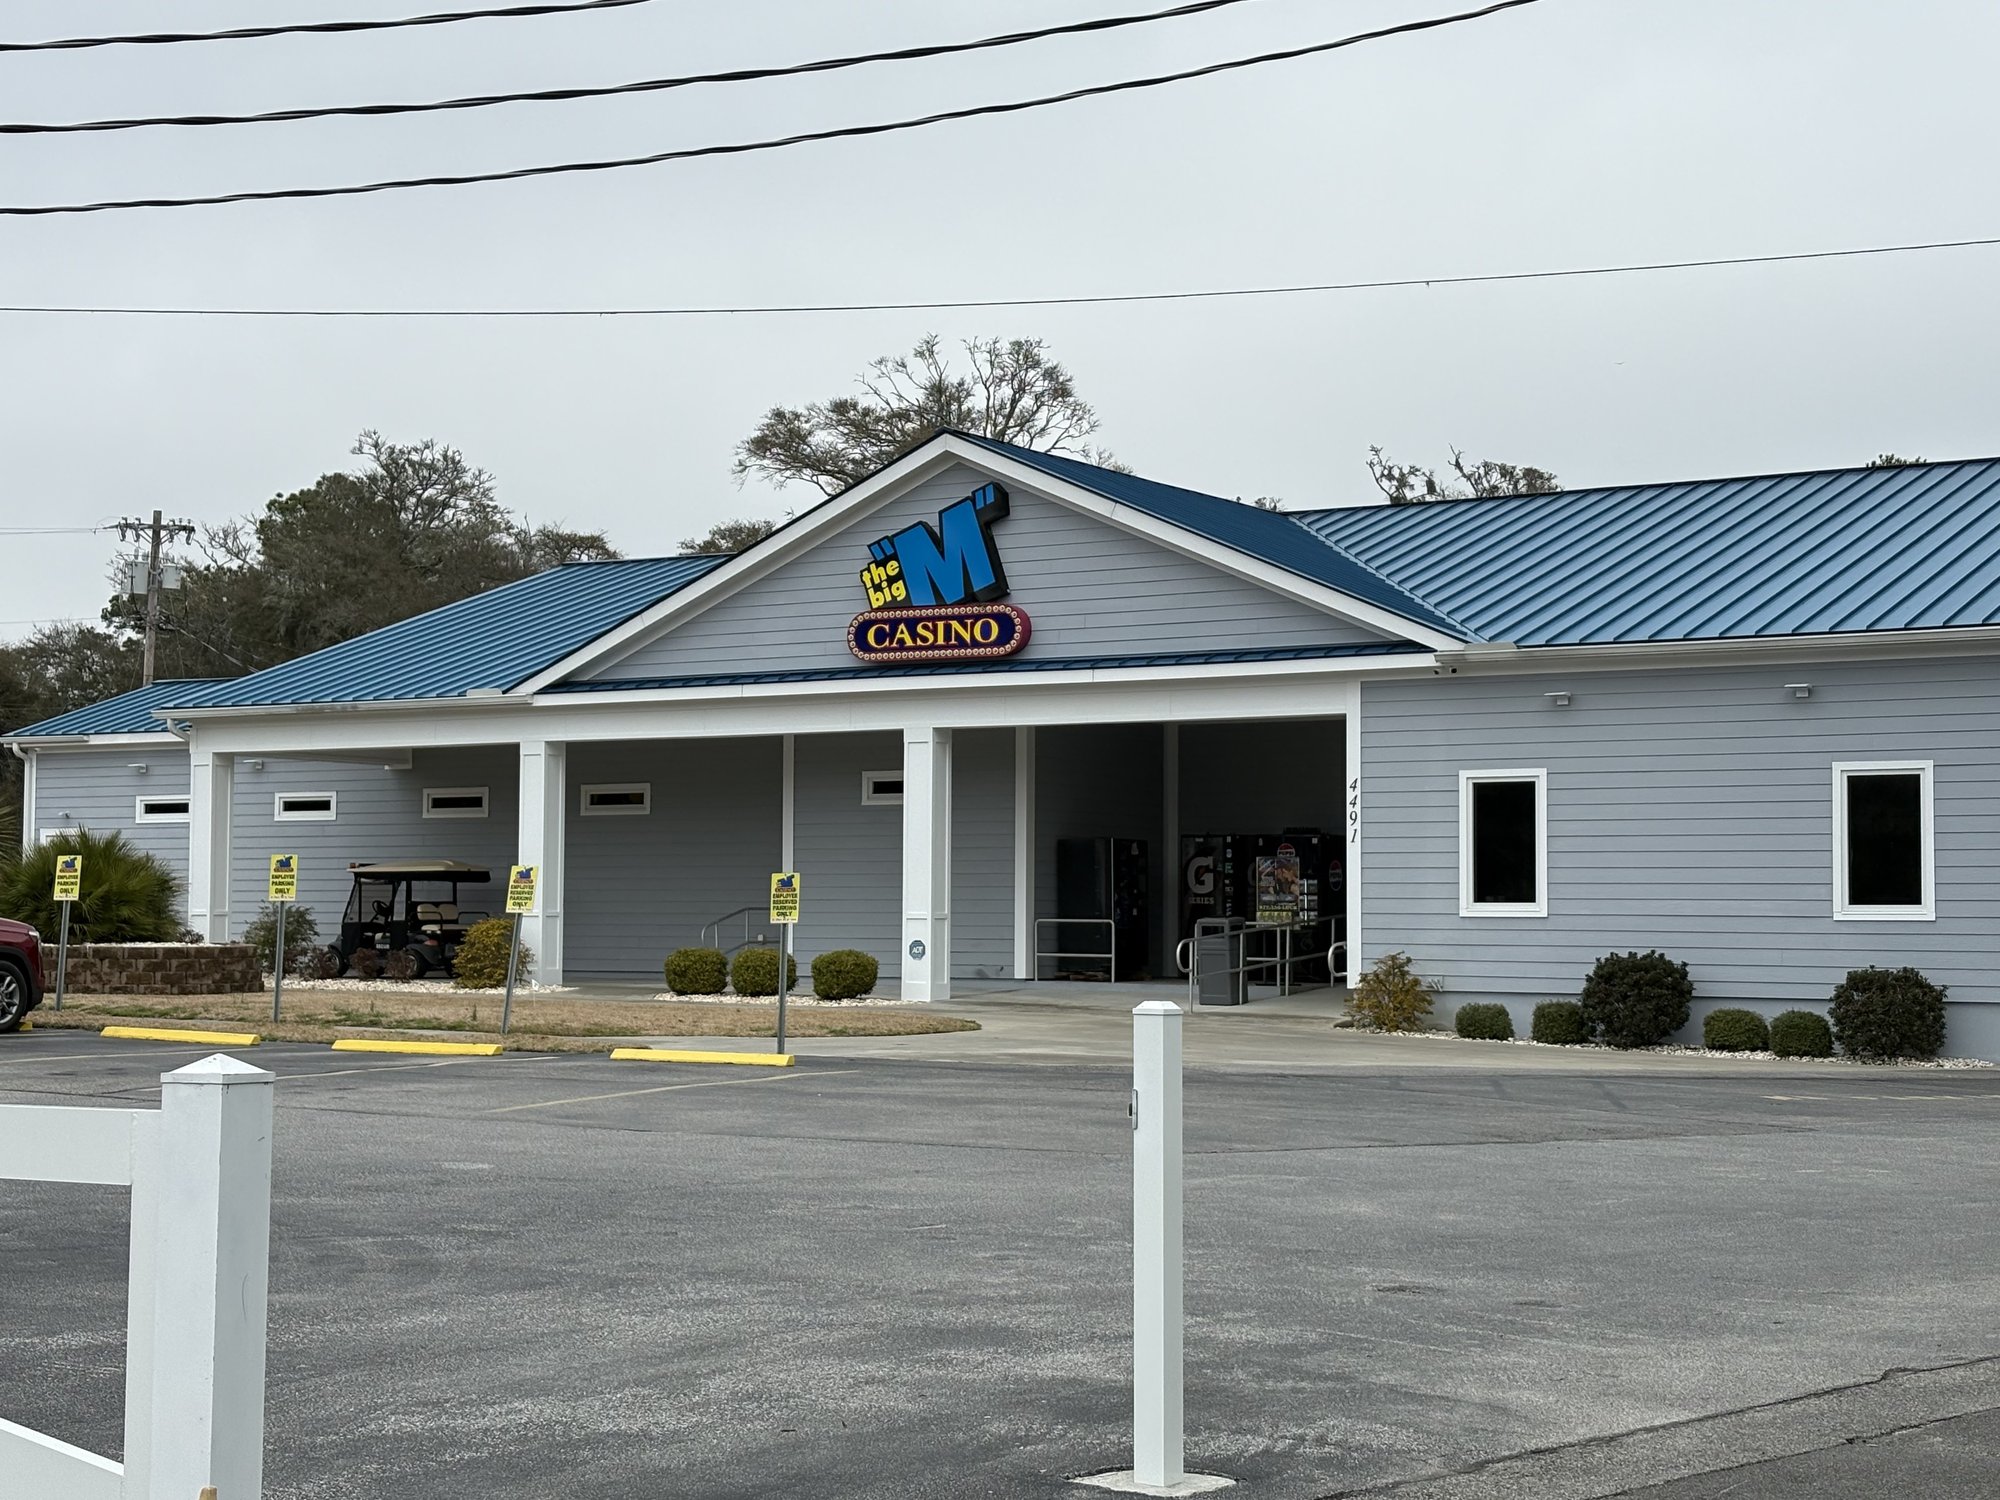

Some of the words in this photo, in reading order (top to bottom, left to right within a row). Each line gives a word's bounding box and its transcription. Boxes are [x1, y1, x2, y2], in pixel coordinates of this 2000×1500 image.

[862, 560, 900, 588] the
[868, 580, 907, 609] big
[867, 618, 999, 648] CASINO
[1349, 777, 1358, 843] 4491
[1187, 856, 1215, 894] G
